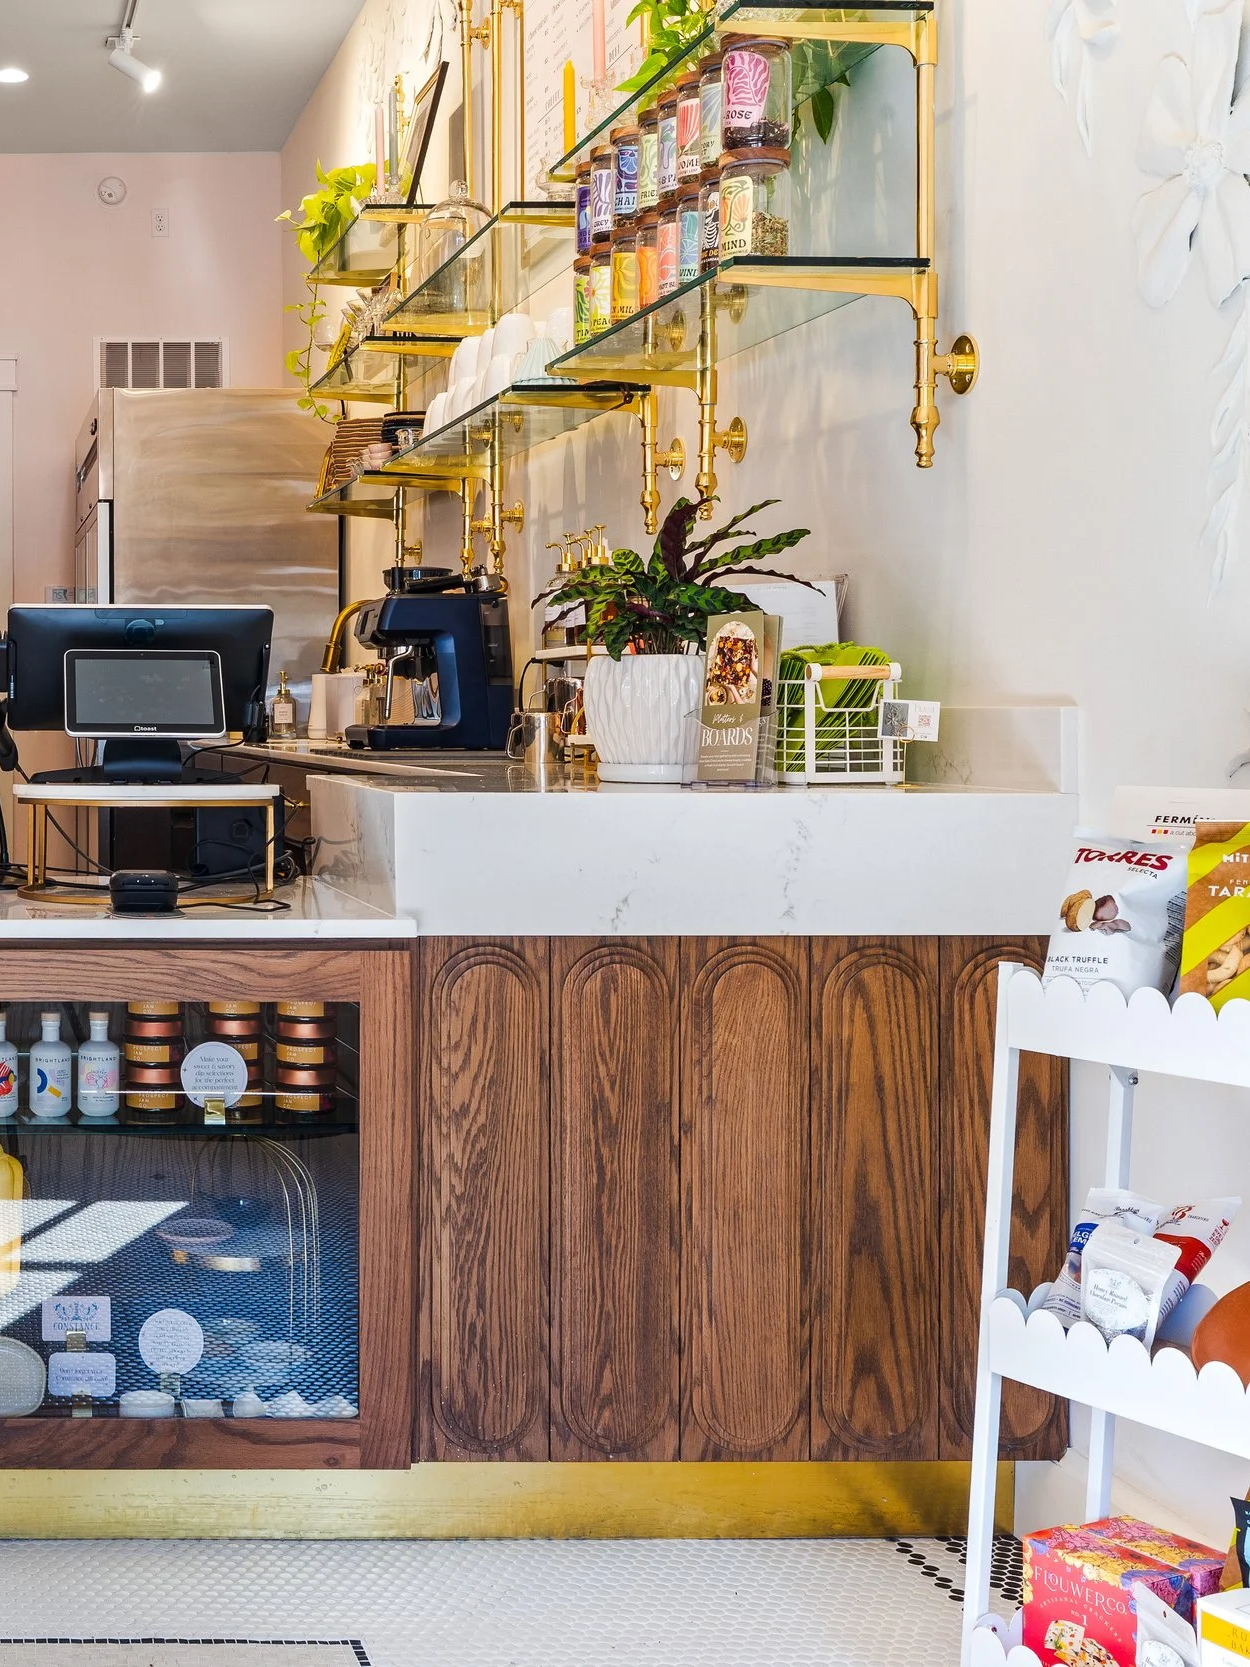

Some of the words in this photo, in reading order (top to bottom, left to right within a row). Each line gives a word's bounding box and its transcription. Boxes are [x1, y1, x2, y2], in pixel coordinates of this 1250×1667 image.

[712, 712, 737, 725] Platters
[702, 727, 753, 747] BOARDS
[1154, 815, 1209, 824] FERMÍ
[1127, 866, 1158, 879] SELECTA
[1072, 956, 1109, 964] TRUFFLE
[1039, 1596, 1078, 1609] ARTISANAL
[1083, 1603, 1122, 1643] CRACKERS
